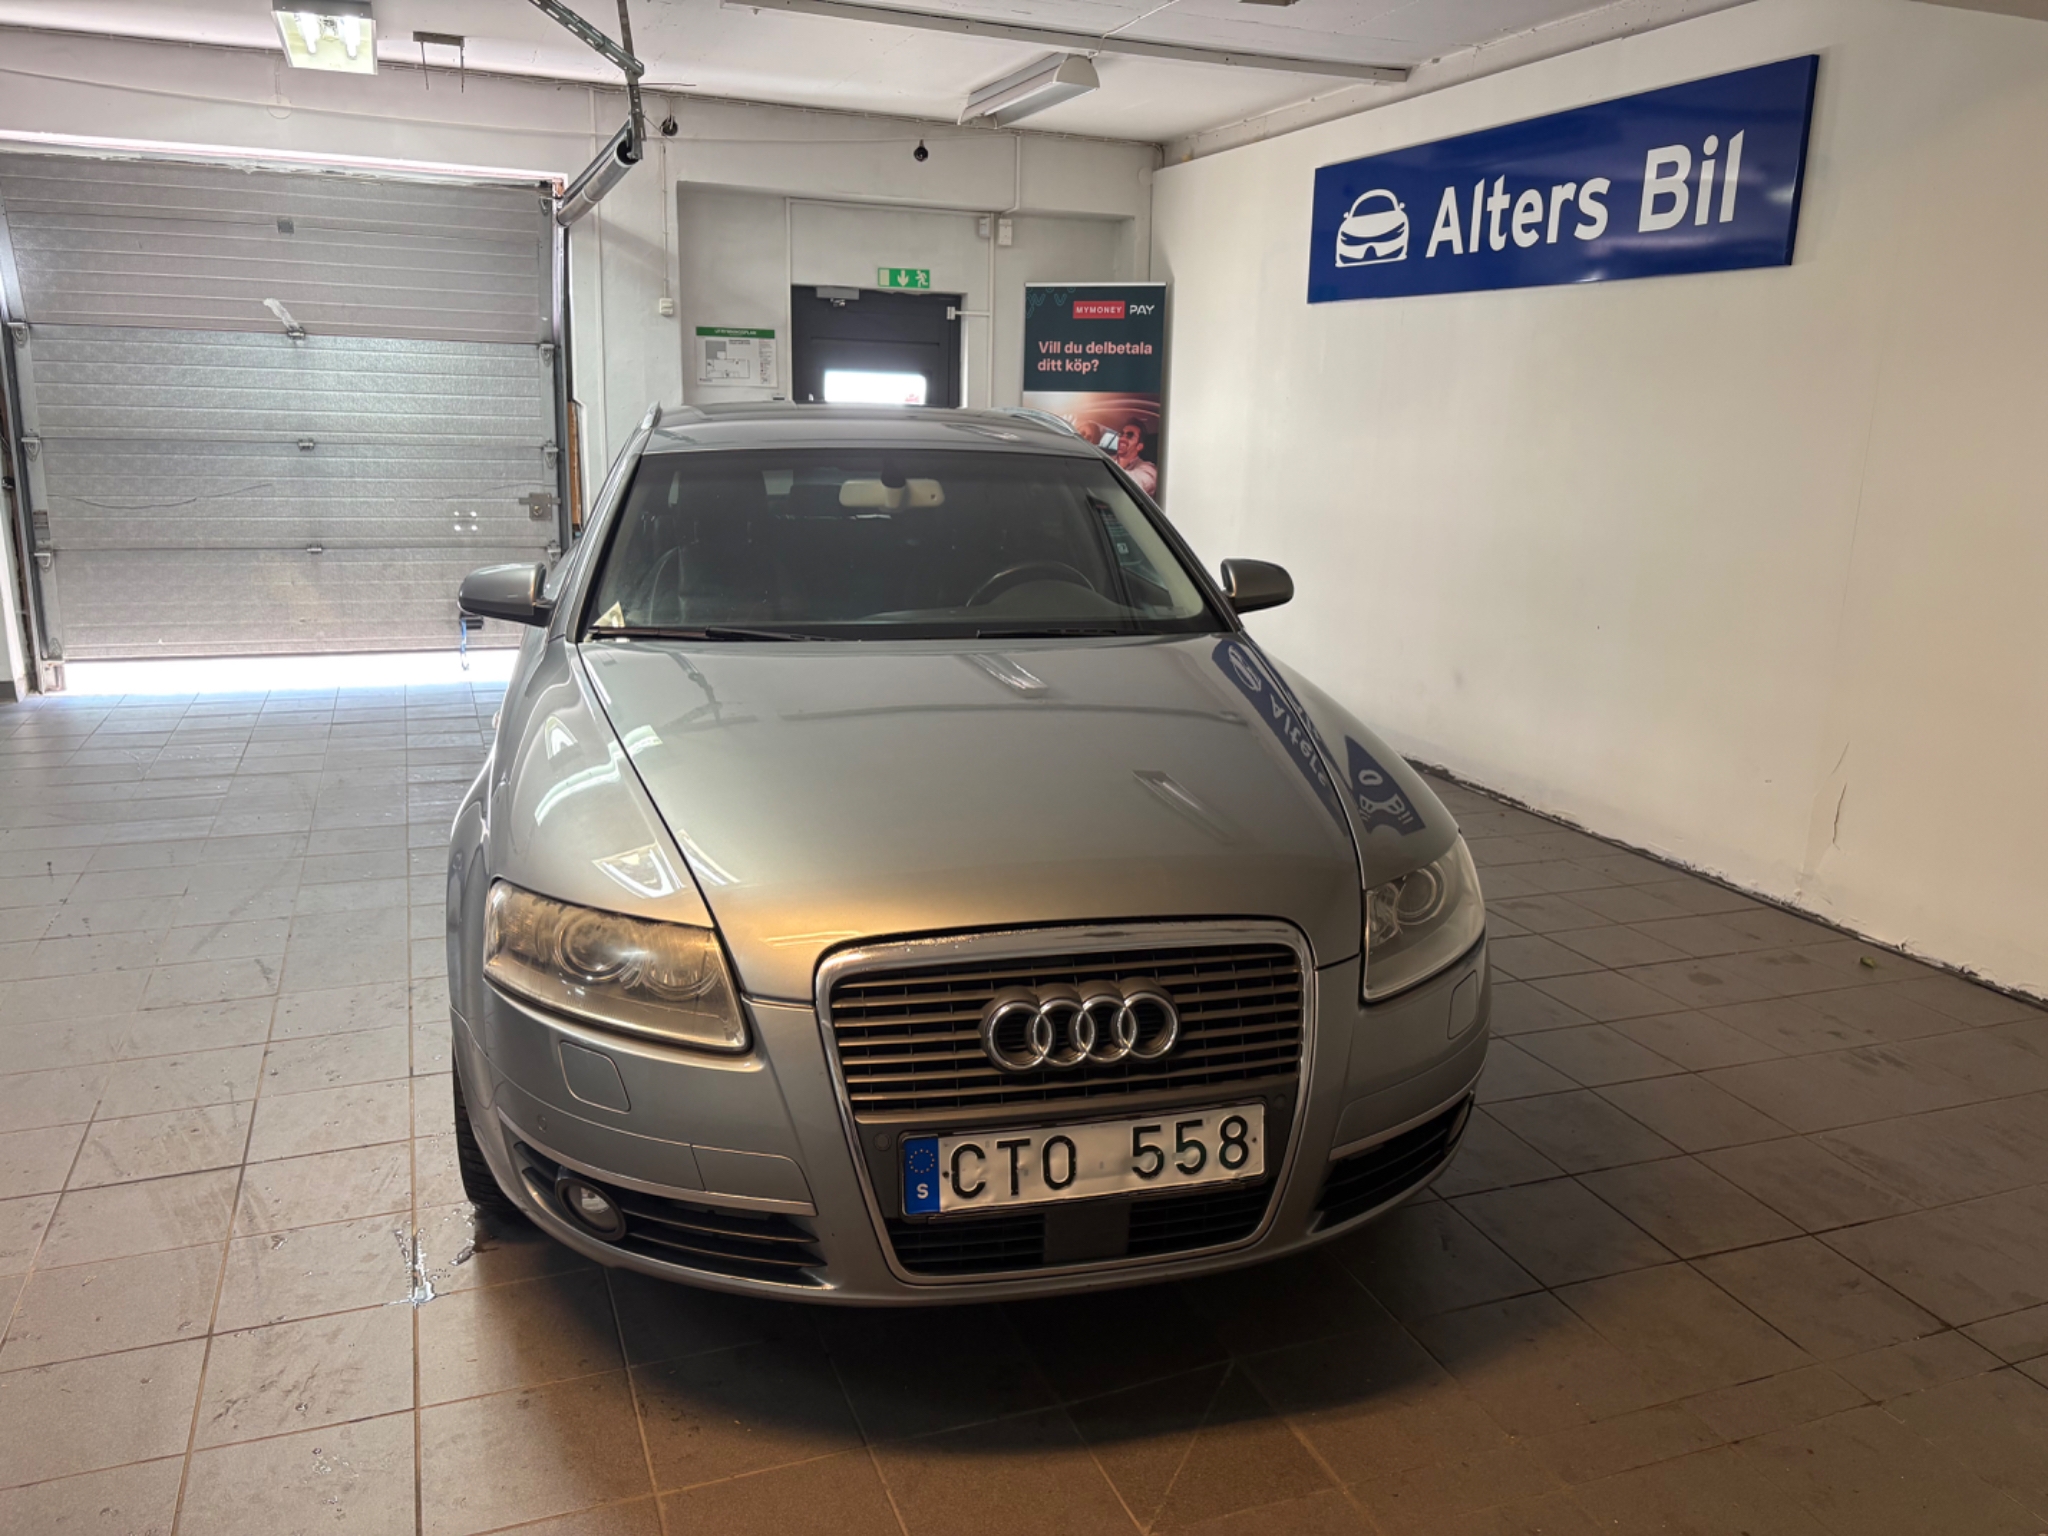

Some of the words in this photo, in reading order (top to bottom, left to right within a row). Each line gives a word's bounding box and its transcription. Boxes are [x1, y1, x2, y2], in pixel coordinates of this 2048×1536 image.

[1425, 174, 1611, 258] Alters
[1638, 129, 1744, 232] Bil
[1076, 305, 1123, 314] MYMONEY
[1129, 304, 1155, 315] PAY
[1038, 341, 1061, 354] Vill
[1064, 341, 1083, 354] du
[1085, 341, 1153, 355] delbetala
[1037, 358, 1062, 371] ditt
[1065, 358, 1099, 375] köp?
[951, 1135, 1077, 1198] CTO
[1131, 1115, 1249, 1179] 558
[916, 1183, 928, 1199] S
